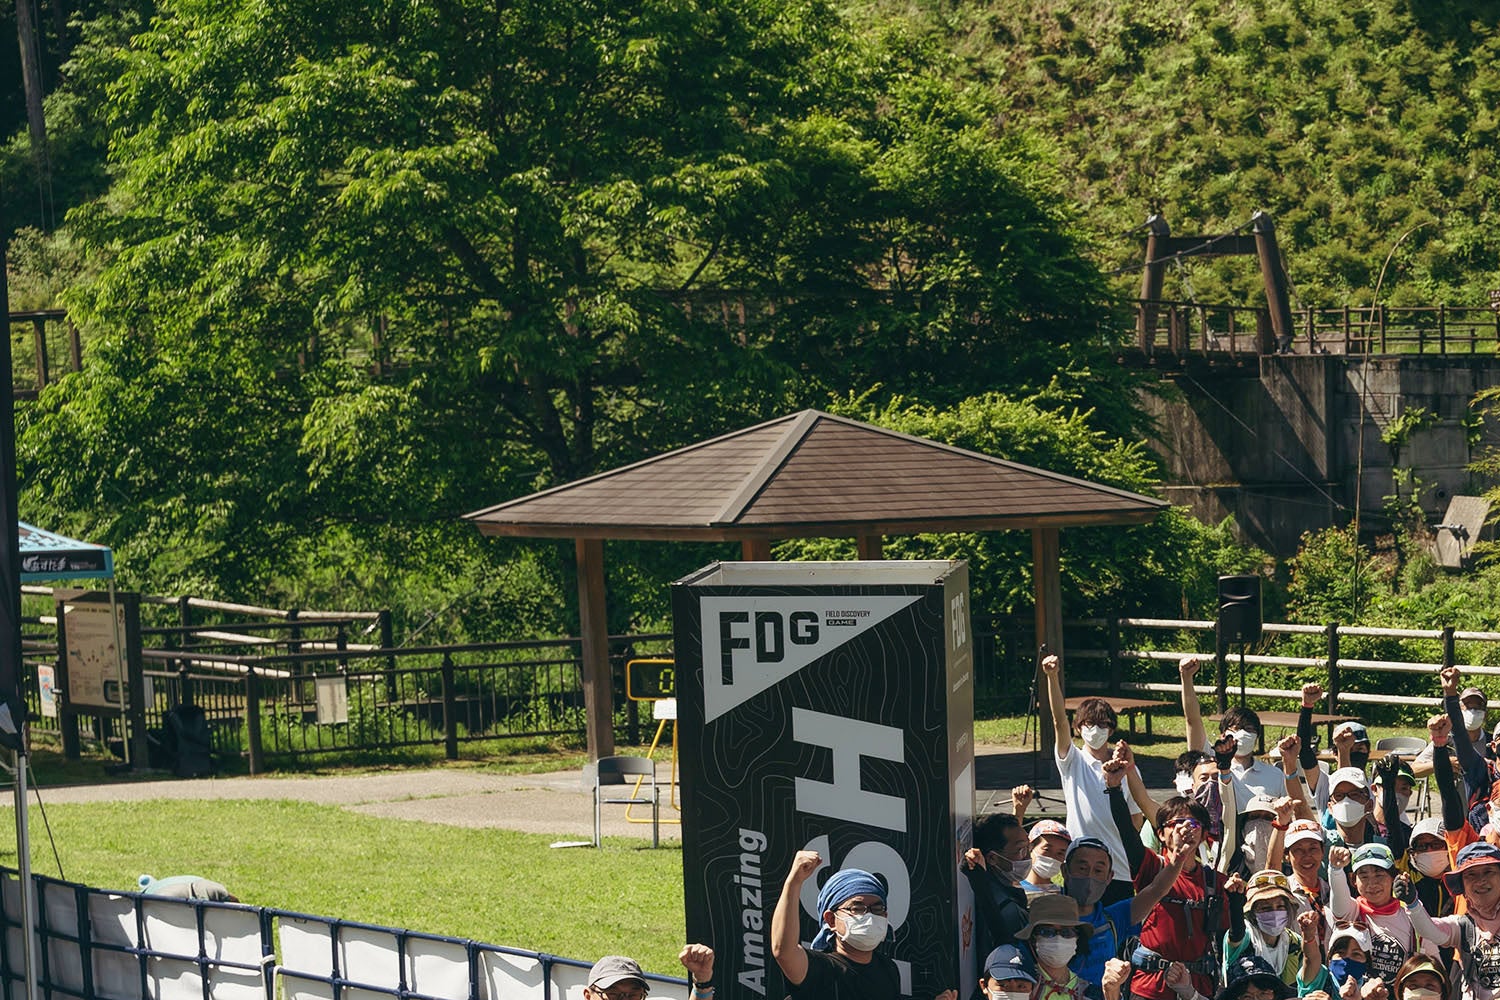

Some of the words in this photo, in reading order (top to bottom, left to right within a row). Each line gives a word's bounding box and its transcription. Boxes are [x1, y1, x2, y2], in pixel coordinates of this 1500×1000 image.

[825, 610, 842, 619] FIELD
[842, 610, 871, 619] DISCOVERY
[827, 619, 855, 627] GAME
[719, 610, 820, 685] FDG
[733, 827, 768, 996] Amazing
